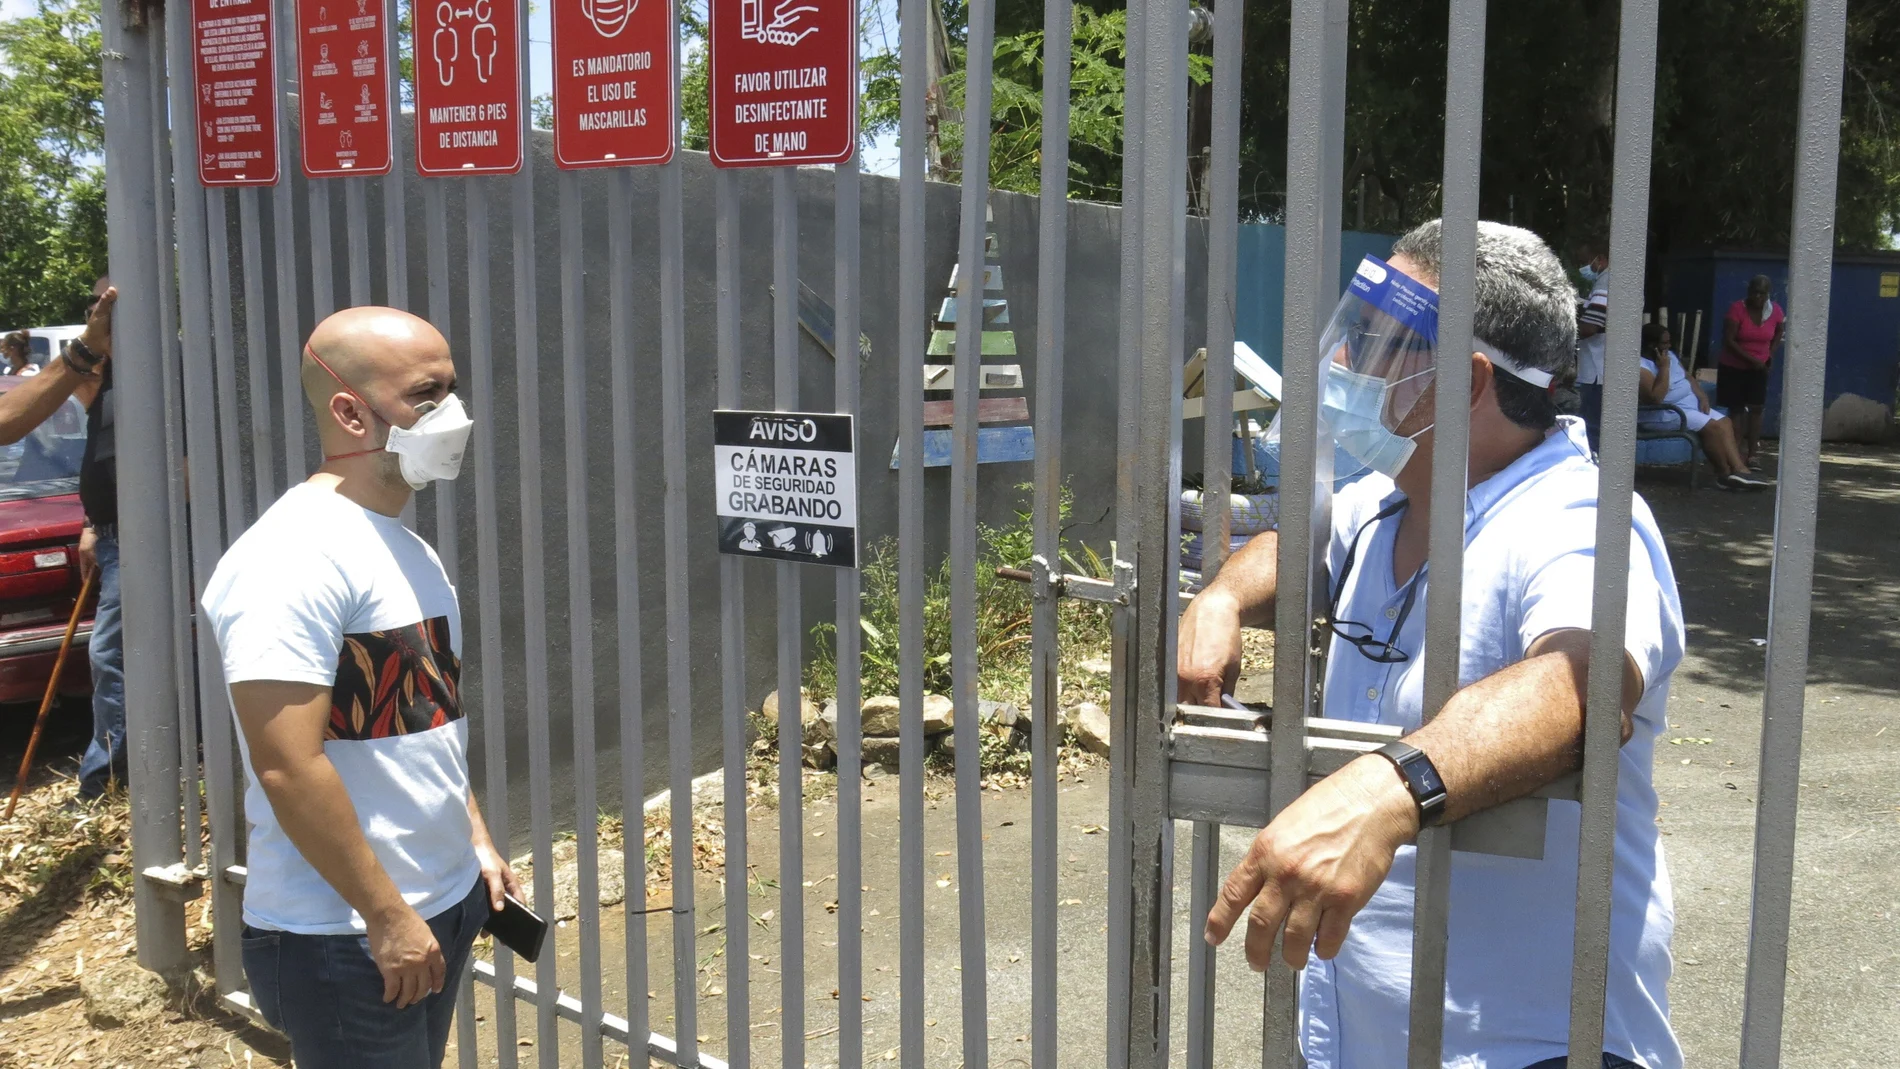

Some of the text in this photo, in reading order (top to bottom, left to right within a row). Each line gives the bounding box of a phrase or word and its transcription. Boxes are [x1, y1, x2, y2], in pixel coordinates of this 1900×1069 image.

[573, 51, 651, 77] ES MANDATORIO
[587, 81, 637, 103] EL USO DE
[735, 67, 827, 93] FAVOR UTILIZAR
[429, 103, 507, 123] MANTENER 6 PIES
[579, 108, 647, 131] MASCARILLAS
[735, 98, 827, 123] DESINFECTANTE
[440, 130, 498, 148] DE DISTANCIA
[755, 131, 807, 153] DE MANO
[750, 416, 817, 443] AVISO
[730, 449, 837, 478] CÁMARAS
[733, 474, 836, 495] DE SEGURIDAD
[729, 491, 842, 520] GRABANDO
